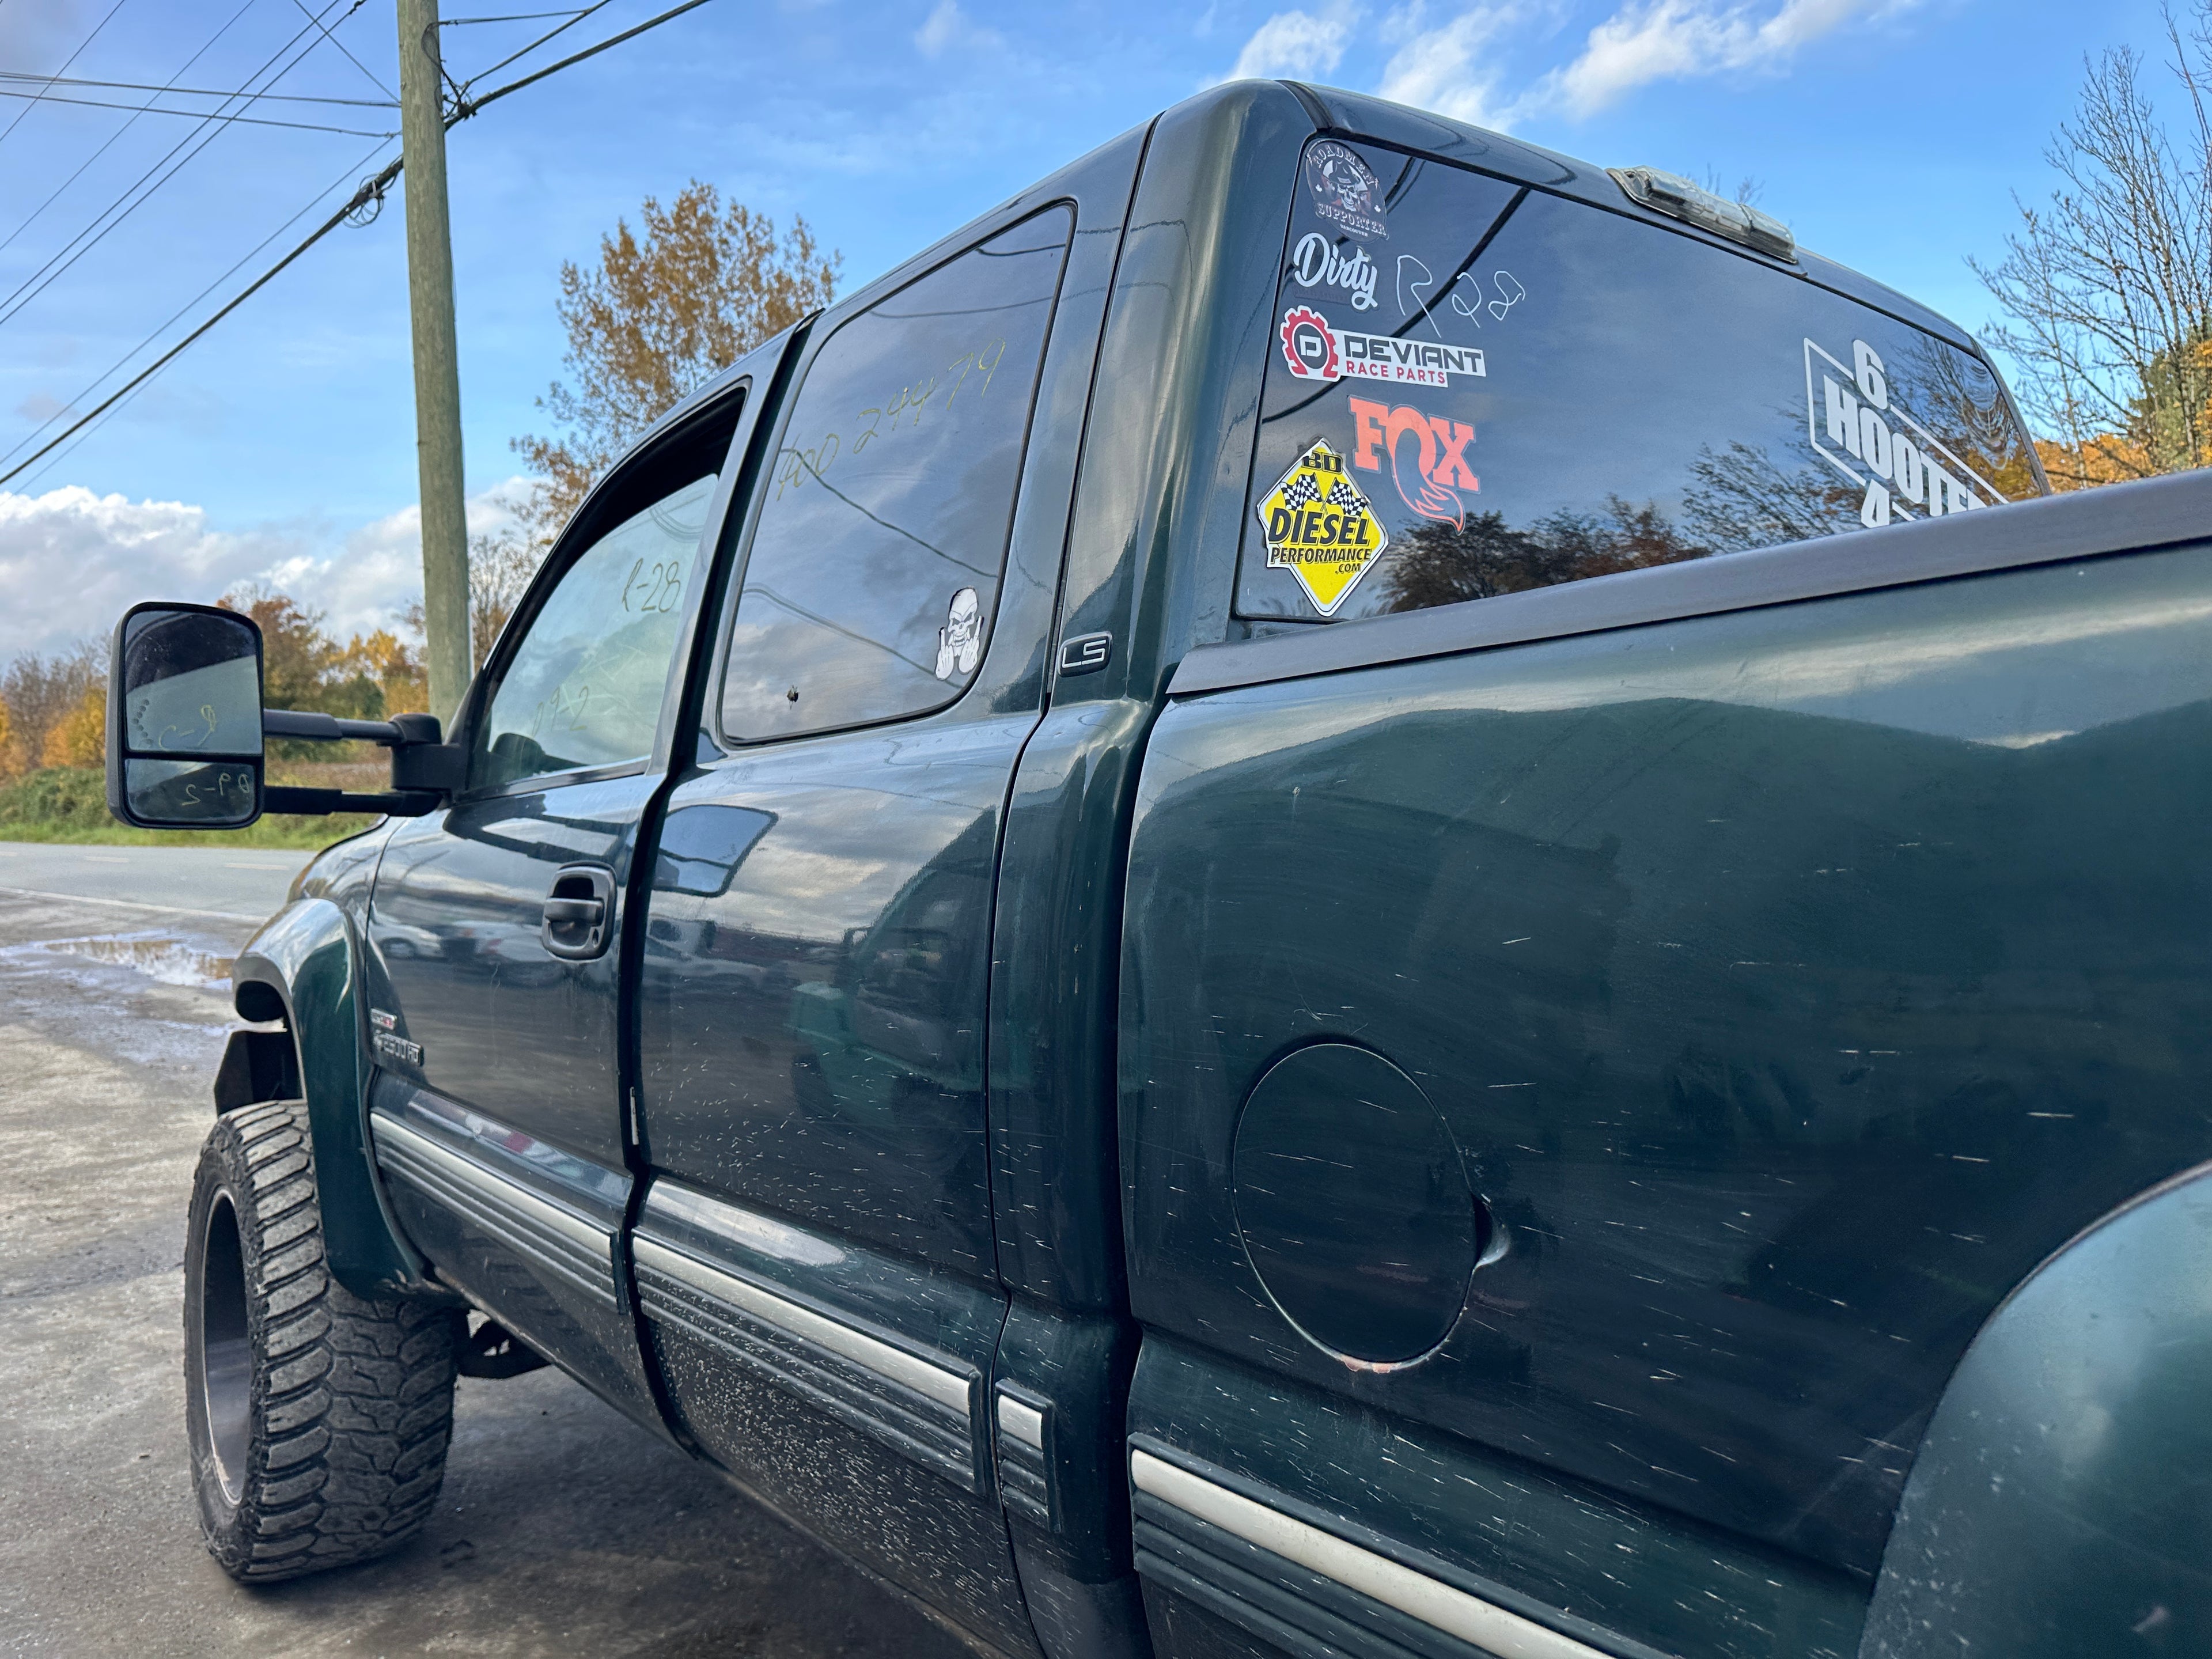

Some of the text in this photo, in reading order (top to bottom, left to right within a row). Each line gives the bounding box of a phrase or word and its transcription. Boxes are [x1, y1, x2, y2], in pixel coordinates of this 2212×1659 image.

[1317, 202, 1387, 236] SUPPORTER
[1340, 224, 1369, 237] VANCOUVER
[1293, 232, 1378, 310] Dirty
[1344, 335, 1482, 373] DEVIANT
[1346, 360, 1446, 384] RACE PARTS
[1853, 339, 1888, 410] 6
[1301, 450, 1343, 475] BD
[1350, 396, 1480, 531] FOX
[1824, 374, 1987, 517] HOOTE
[1268, 507, 1370, 547] DIESEL
[1270, 547, 1372, 565] PERFORMANCE
[1062, 639, 1107, 668] LS
